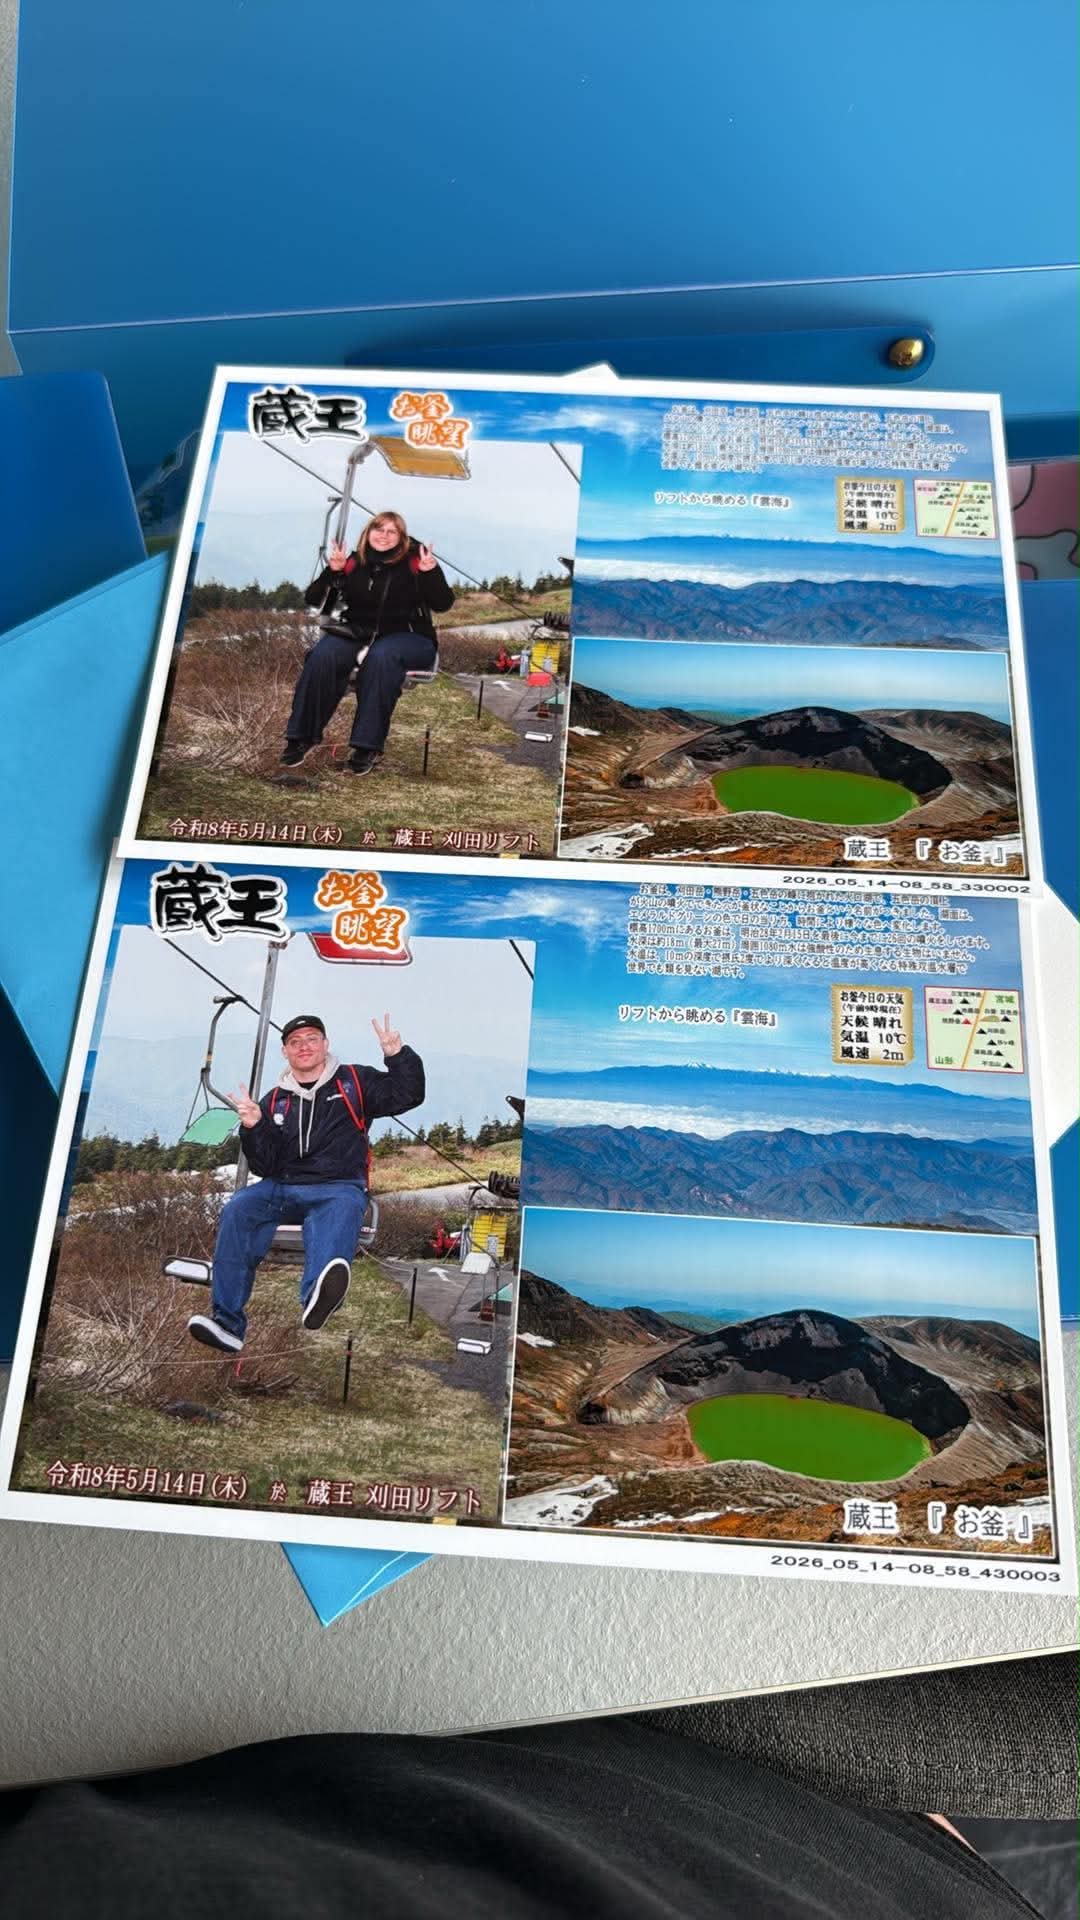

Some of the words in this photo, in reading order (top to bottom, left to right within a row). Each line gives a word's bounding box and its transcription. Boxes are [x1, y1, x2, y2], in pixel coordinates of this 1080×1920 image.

[252, 388, 365, 443] 蔵王
[392, 393, 449, 419] お釜
[407, 419, 469, 448] 眺望
[880, 522, 897, 531] 2m
[169, 817, 344, 844] 令和8年5月14日(木)
[361, 830, 377, 845] 於
[394, 828, 433, 847] 蔵王
[442, 830, 541, 851] 刈田リフト
[847, 839, 890, 859] 蔵王
[153, 861, 285, 940] 蔵王
[317, 871, 385, 908] お釜
[335, 908, 408, 950] 眺望
[840, 991, 904, 1005] お釜今日の天気
[619, 1005, 777, 1027] リフトから眺める『雲海』
[841, 1015, 869, 1028] 天候
[873, 1016, 903, 1029] 晴れ
[840, 1030, 869, 1043] 気温
[841, 1046, 870, 1060] 風速
[882, 1049, 904, 1061] 2m
[935, 1056, 953, 1064] 山形
[46, 1460, 248, 1501] 令和8年5月14日(木)
[270, 1481, 287, 1503] 於
[307, 1479, 353, 1506] 蔵王
[366, 1482, 482, 1516] 刈田リフト
[847, 1502, 895, 1531] 蔵王
